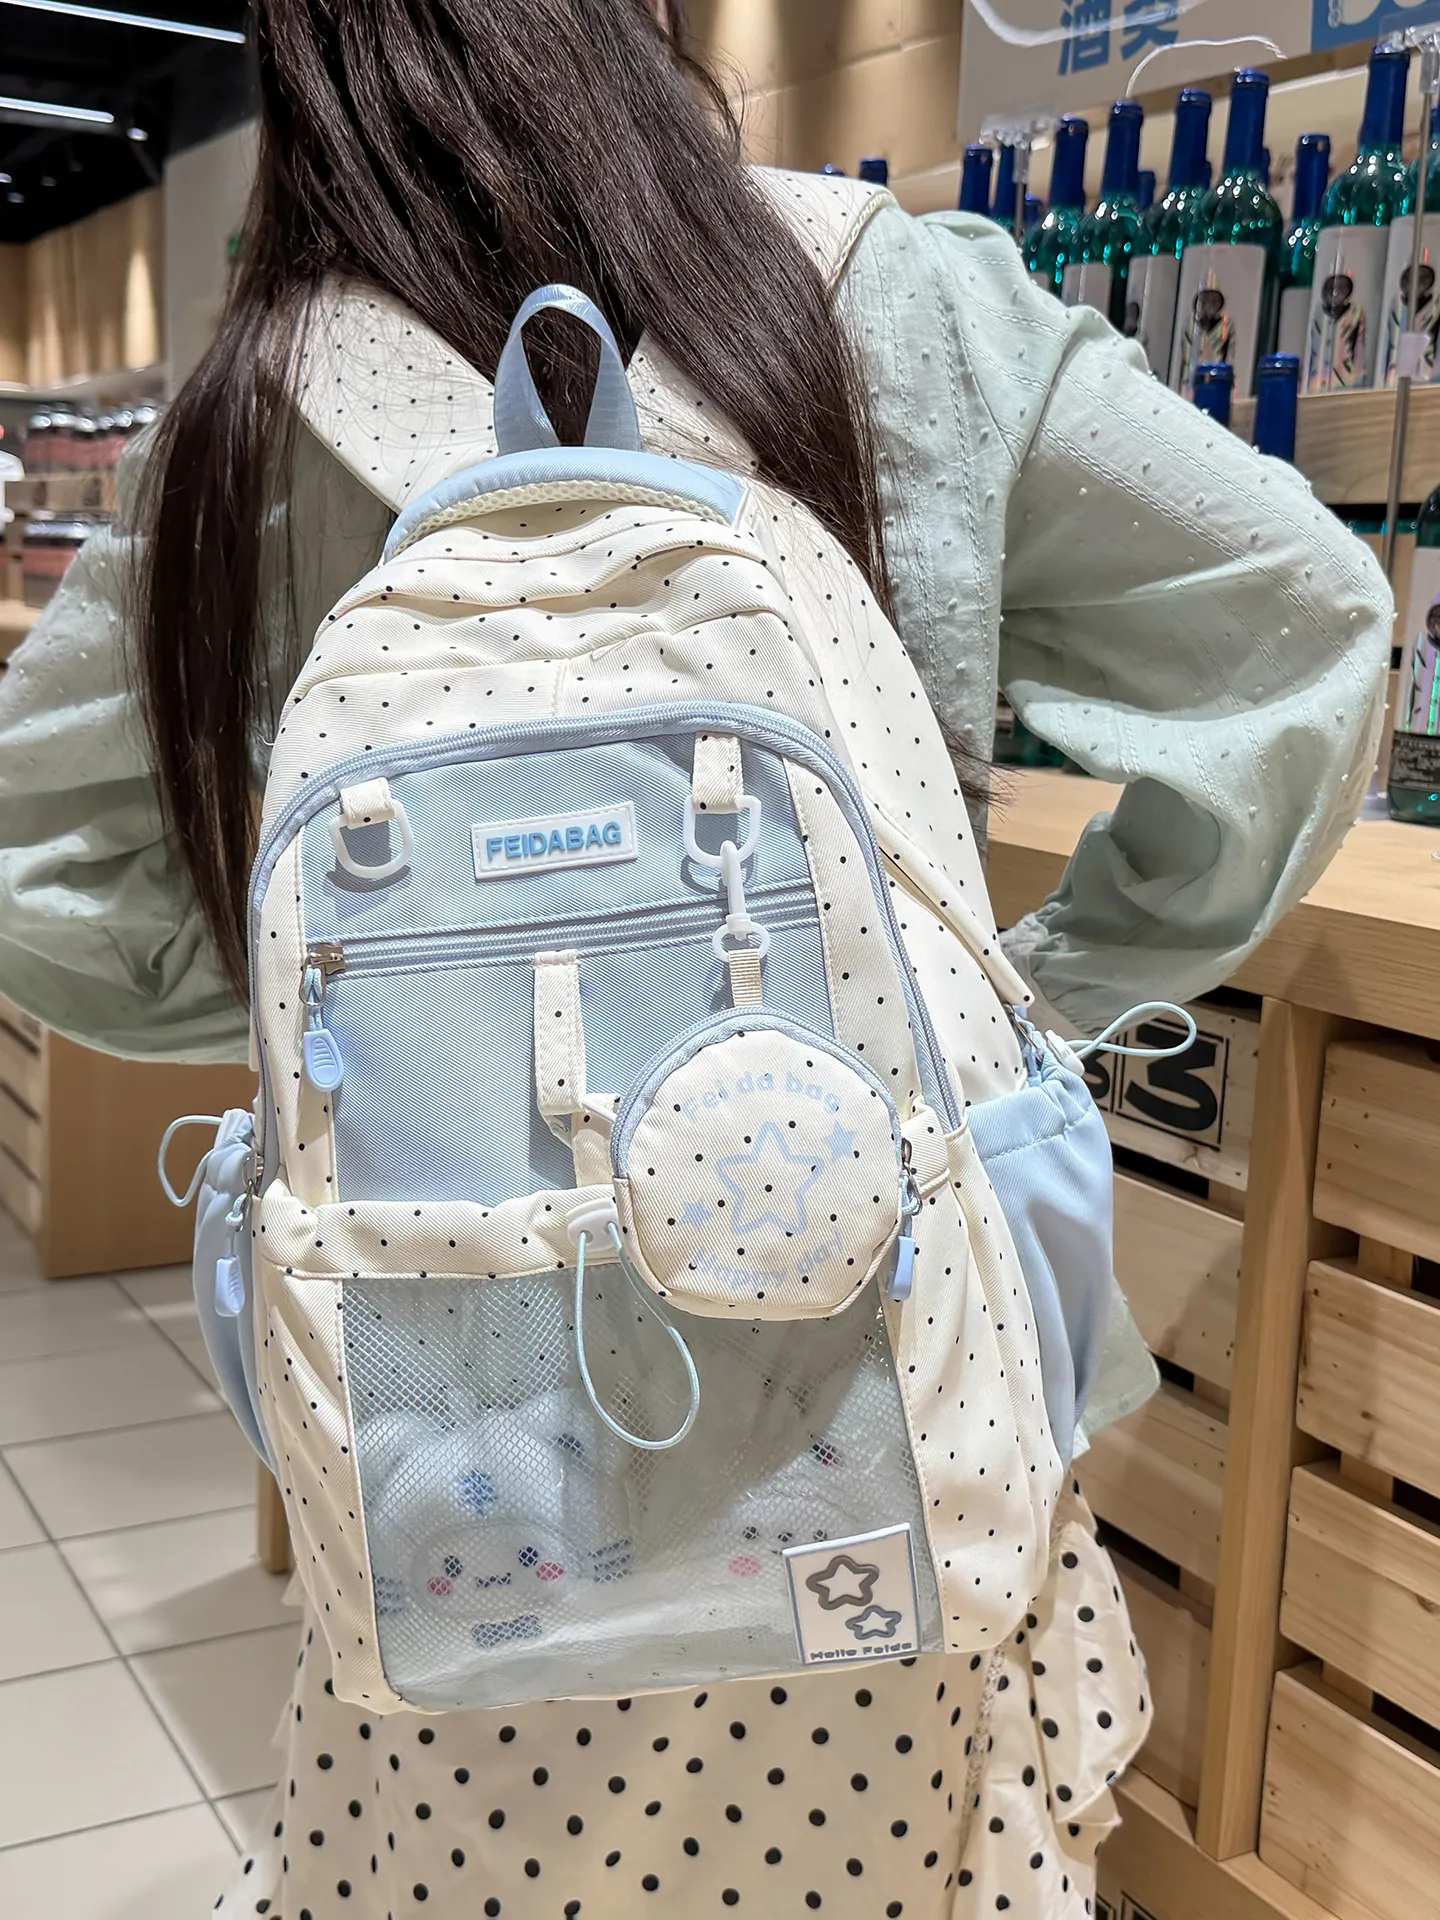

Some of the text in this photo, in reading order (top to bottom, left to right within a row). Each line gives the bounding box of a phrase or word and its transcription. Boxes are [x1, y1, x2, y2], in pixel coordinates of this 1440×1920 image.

[486, 821, 622, 862] FEIDABAG
[736, 1071, 775, 1095] da
[785, 1071, 841, 1115] bag
[810, 1649, 857, 1660] Hello
